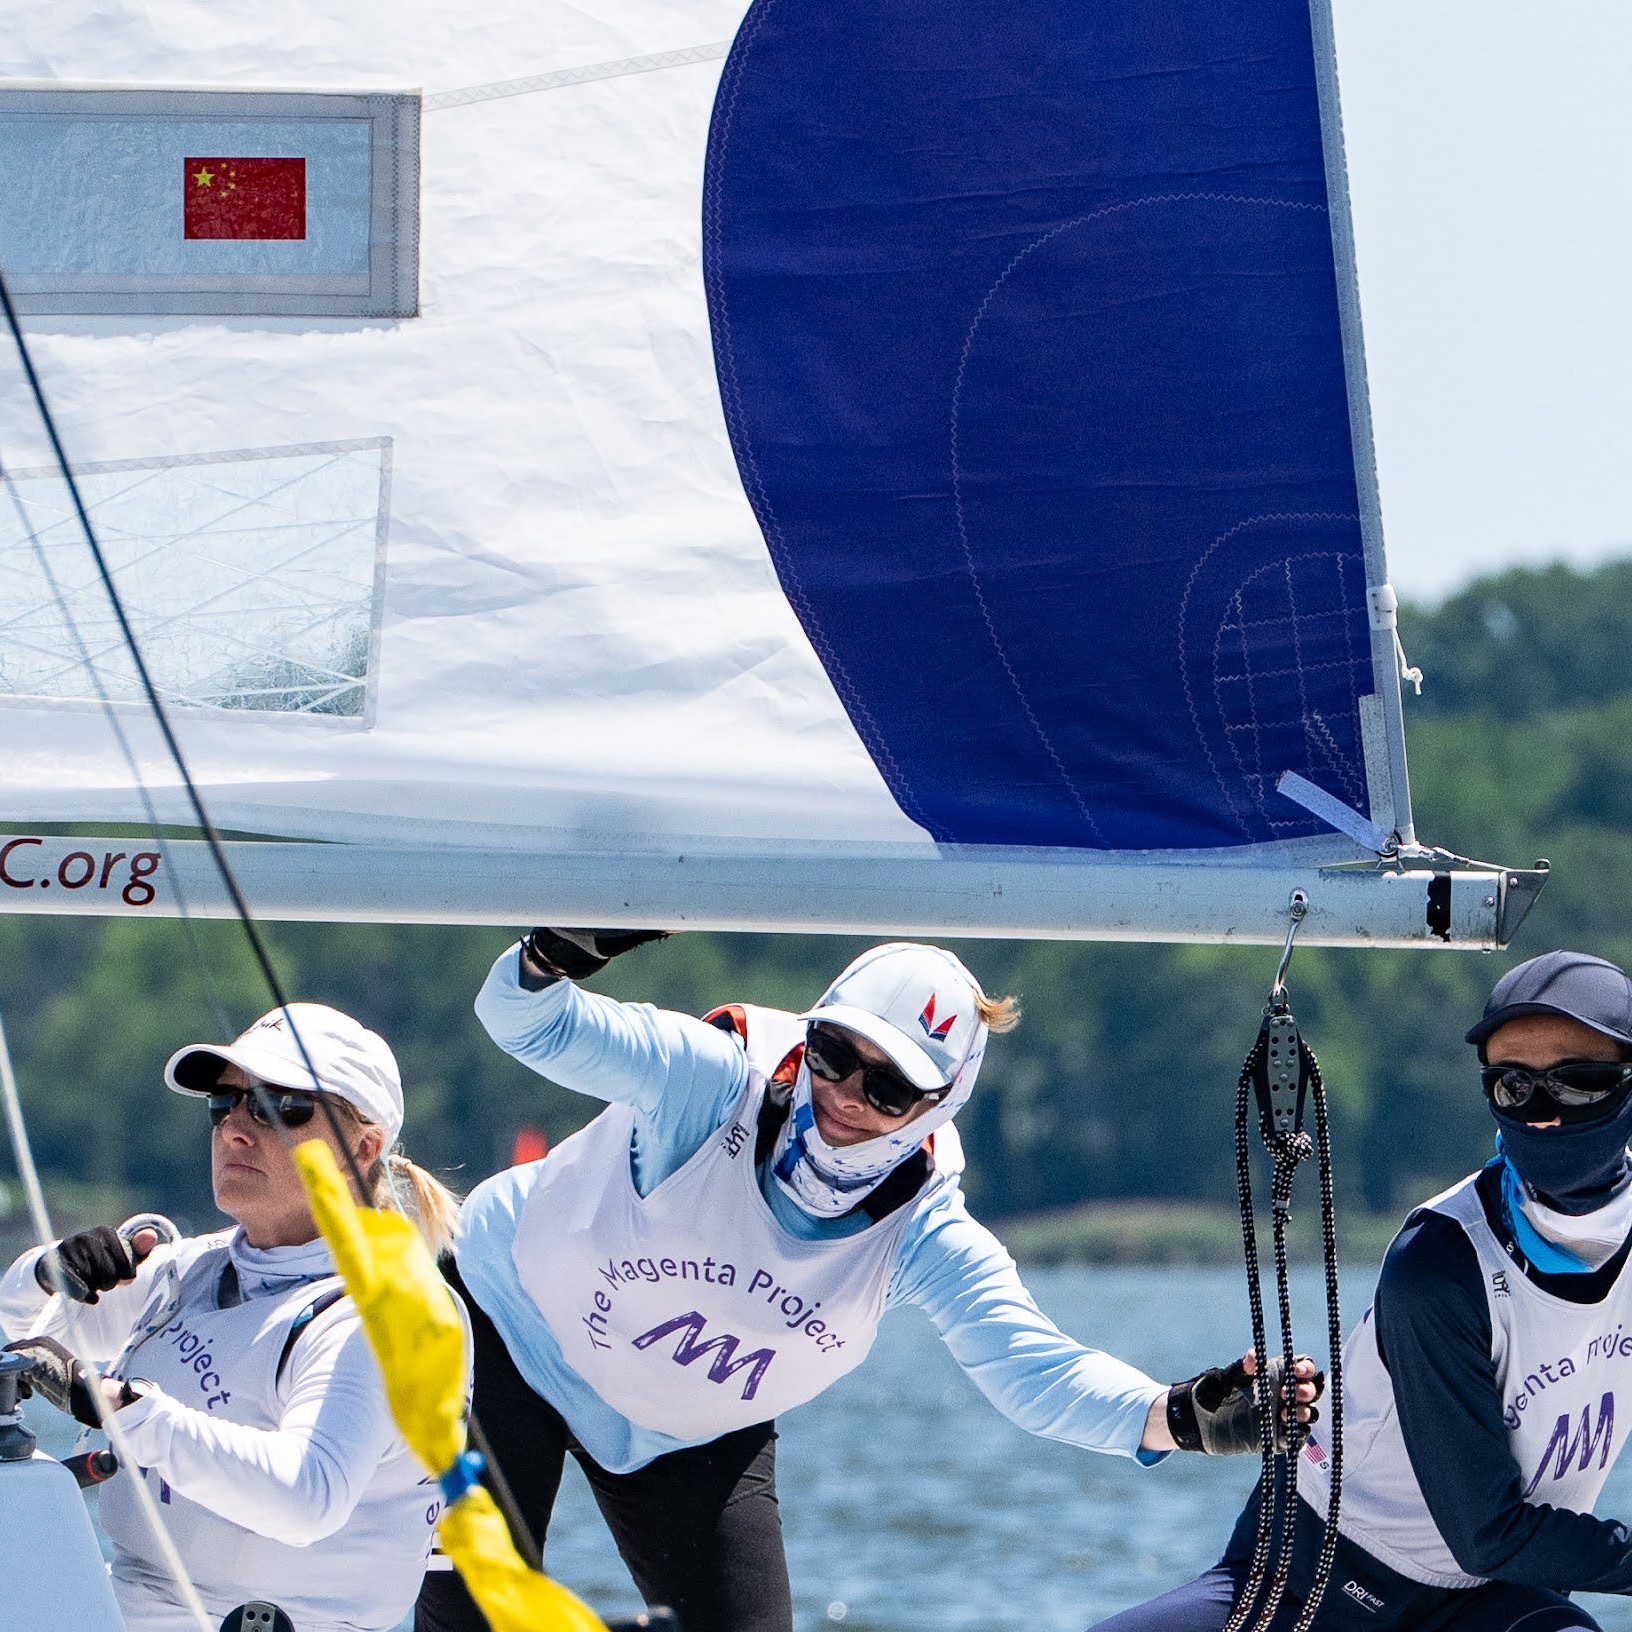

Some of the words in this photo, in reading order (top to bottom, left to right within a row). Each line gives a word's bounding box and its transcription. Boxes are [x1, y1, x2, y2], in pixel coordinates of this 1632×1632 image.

[582, 1290, 612, 1350] The
[598, 1256, 736, 1291] Magenta
[747, 1268, 846, 1353] Project
[1343, 1580, 1369, 1601] DRI
